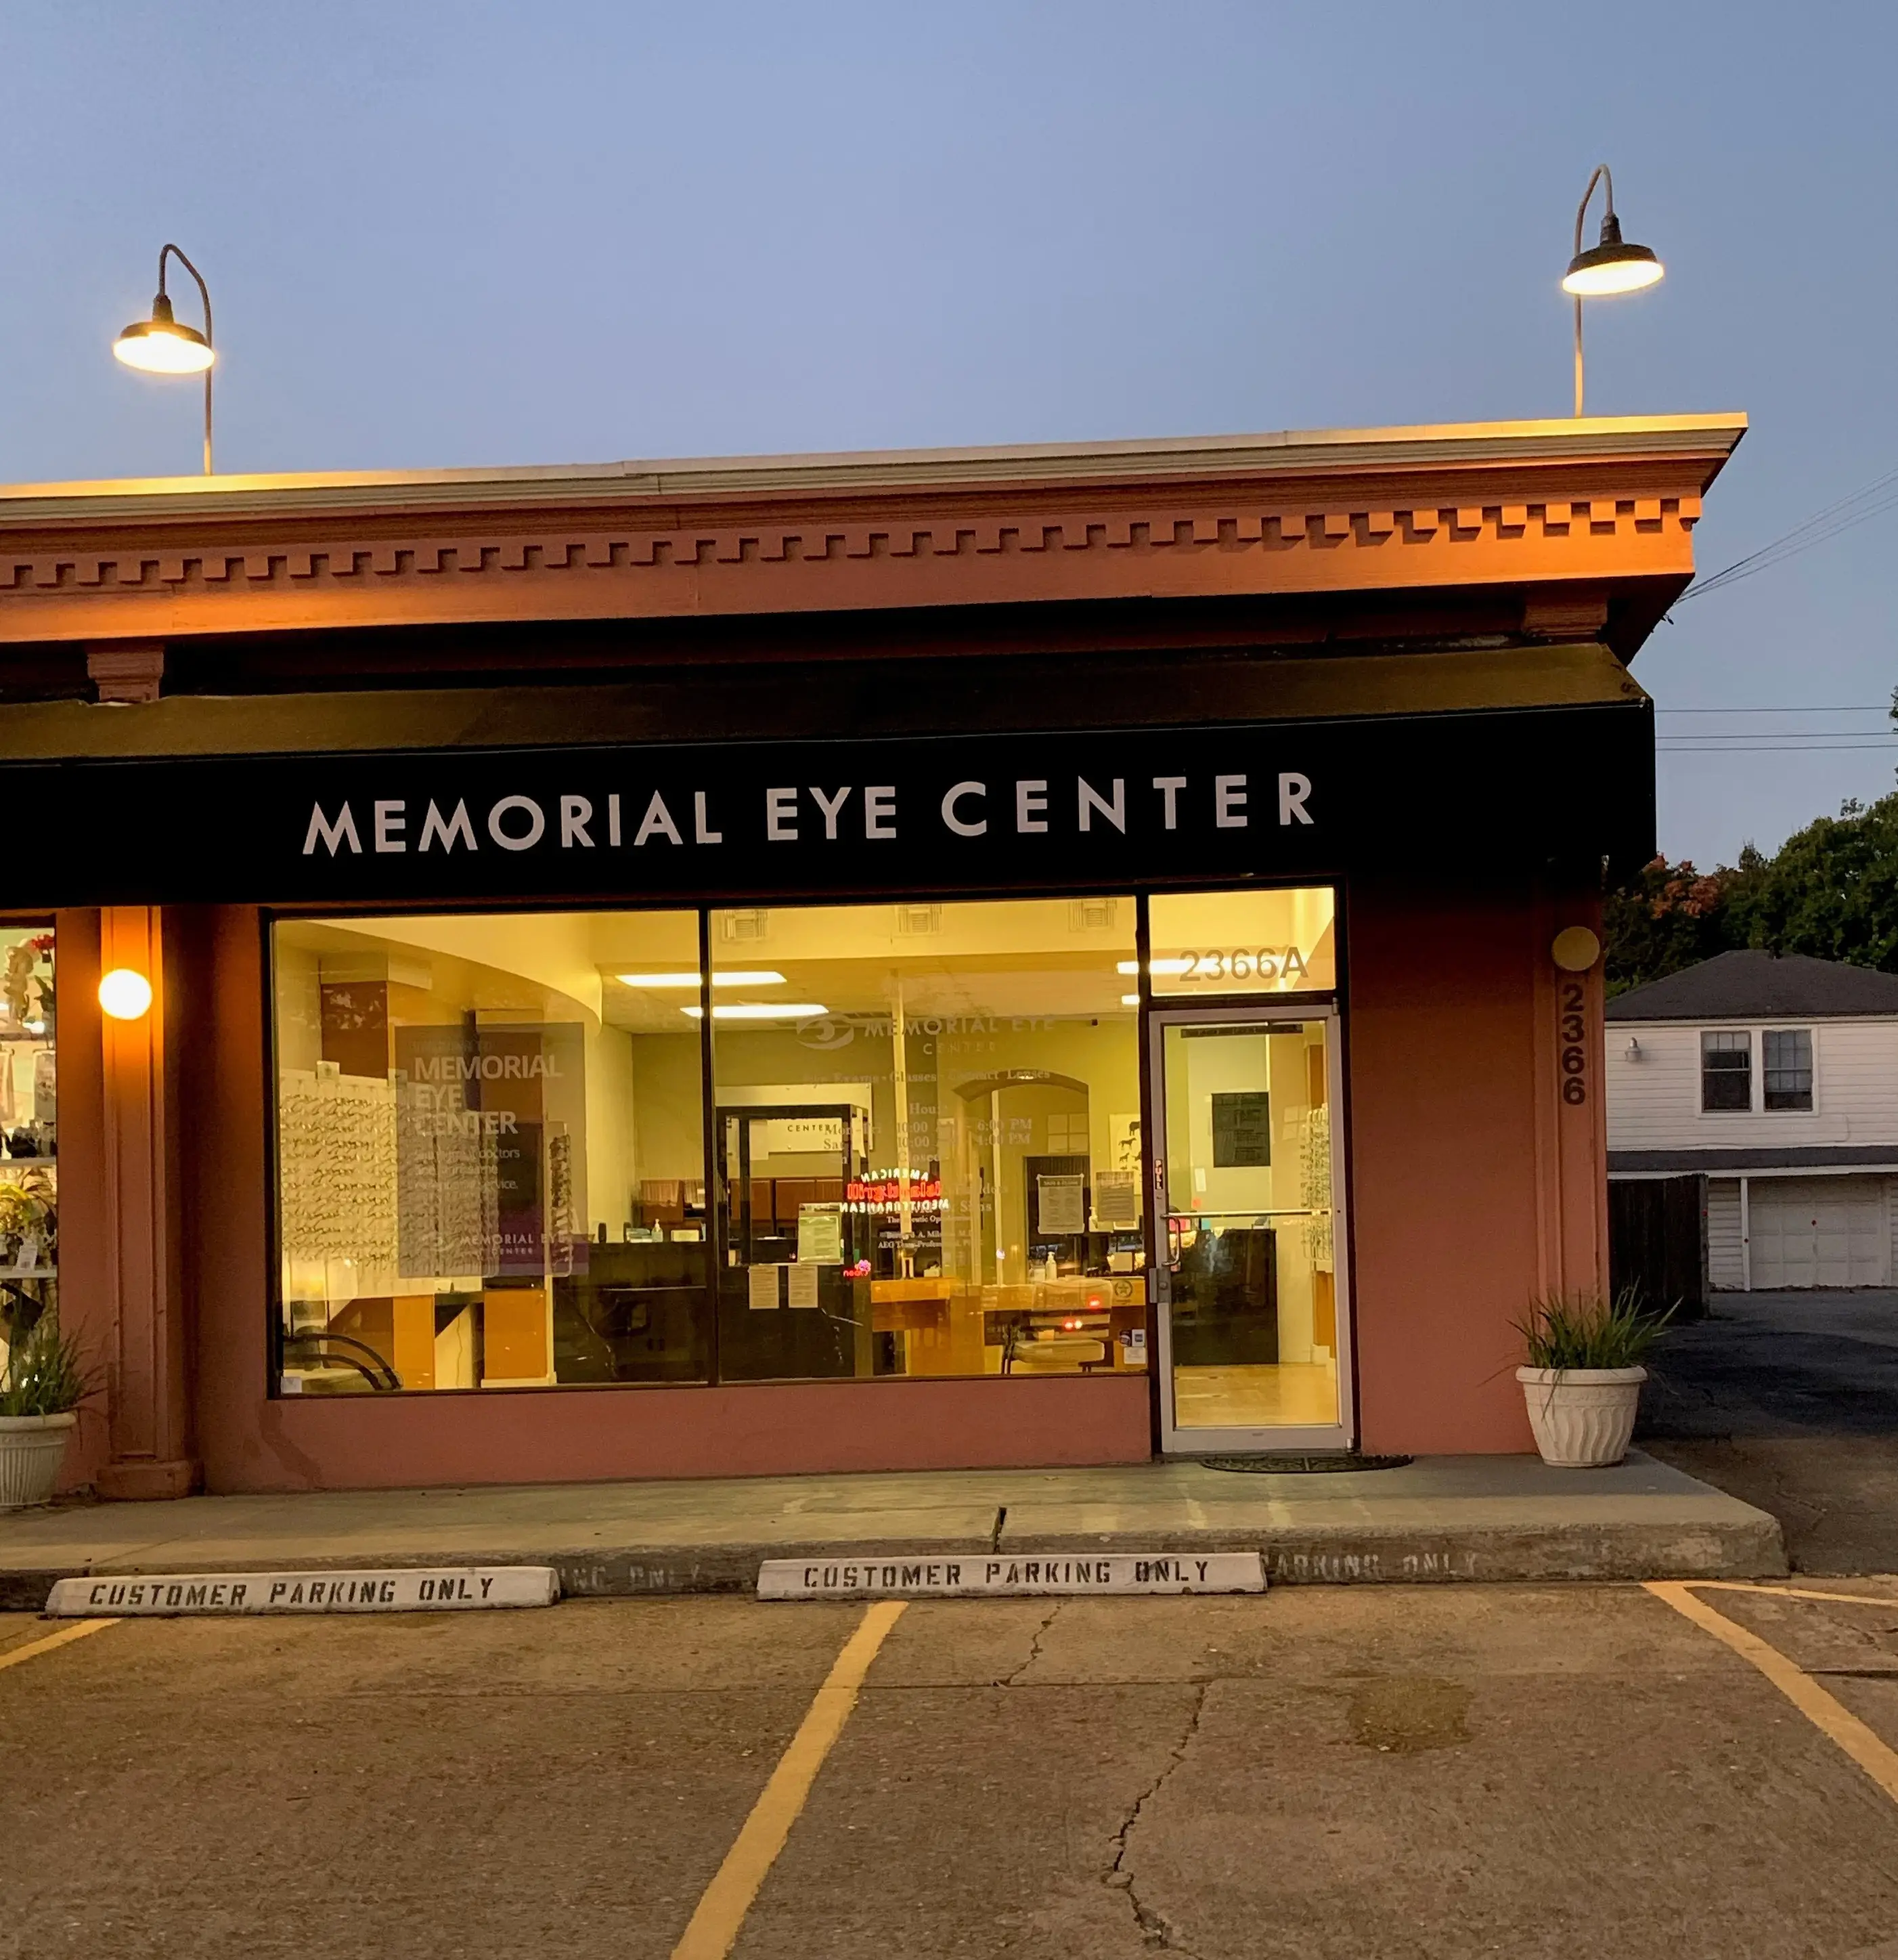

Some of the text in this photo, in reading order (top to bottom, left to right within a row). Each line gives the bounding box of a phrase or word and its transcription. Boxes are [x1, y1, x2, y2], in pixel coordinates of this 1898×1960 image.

[302, 772, 1315, 858] MEMORIAL EYE CENTER
[1179, 946, 1308, 982] 2366A
[864, 1016, 998, 1038] MEMORIAL
[1562, 983, 1585, 1106] 2366
[414, 1054, 565, 1081] MEMORIAL
[889, 1070, 937, 1083] Glasses
[1007, 1068, 1051, 1080] Lenses
[414, 1083, 462, 1109] EYE
[909, 1102, 948, 1114] Hou
[414, 1111, 519, 1135] CENTER
[1010, 1118, 1032, 1130] PM
[898, 1151, 941, 1162] Cosed
[460, 1234, 534, 1245] MEMORIAL
[804, 1561, 1208, 1587] CUSTOMER PARKING ONLY
[1263, 1554, 1382, 1579] ARKING
[89, 1577, 493, 1606] CUSTOMER PARKING ONLY
